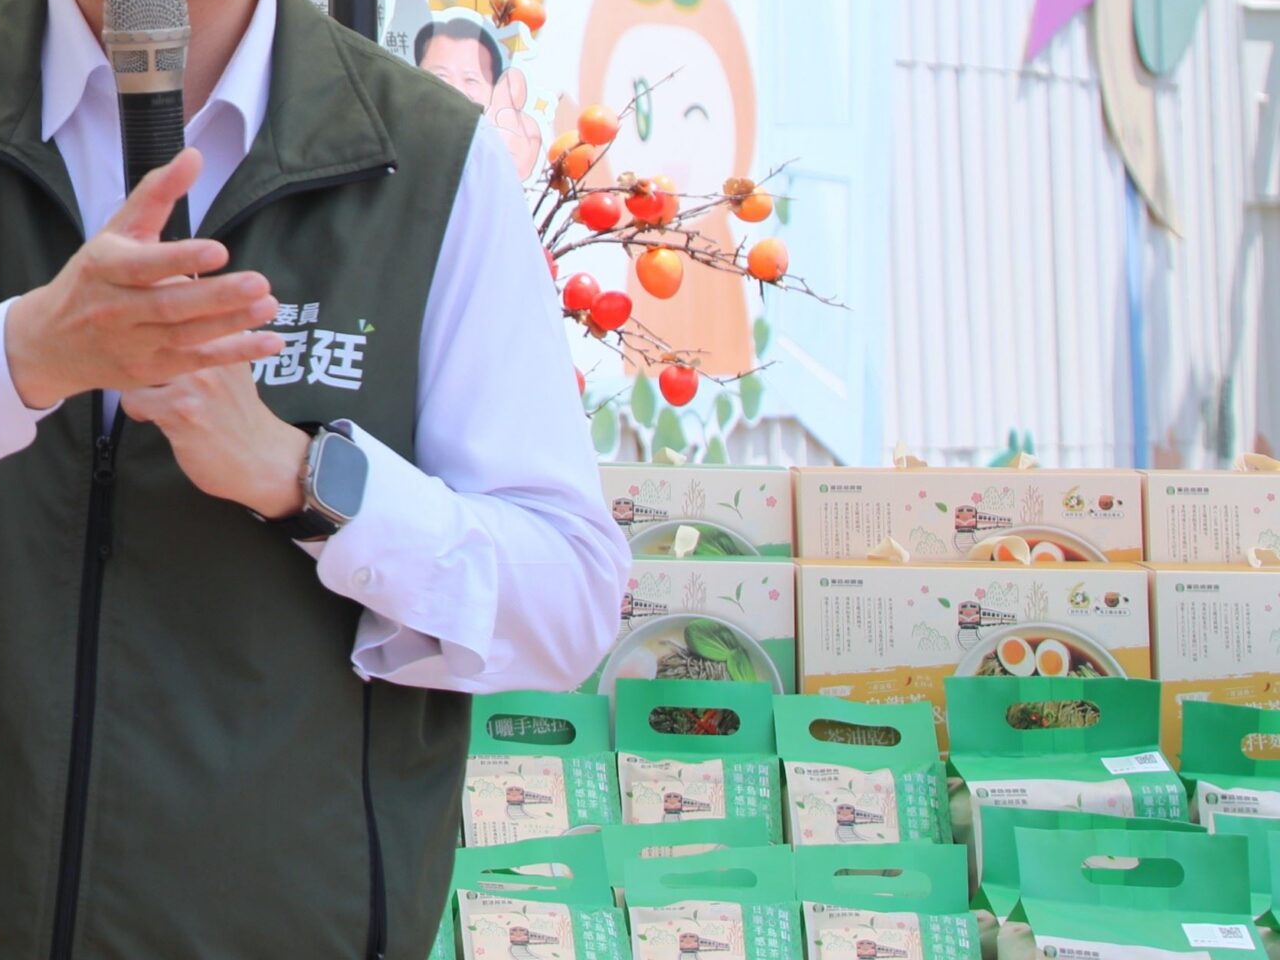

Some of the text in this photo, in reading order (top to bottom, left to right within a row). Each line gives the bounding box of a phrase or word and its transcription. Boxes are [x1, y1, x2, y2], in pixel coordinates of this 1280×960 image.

[268, 302, 320, 326] 委員
[246, 329, 367, 390] 冠廷
[489, 717, 569, 737] 曬手感拉
[759, 764, 770, 799] 阿里山
[1166, 784, 1181, 818] 阿里山
